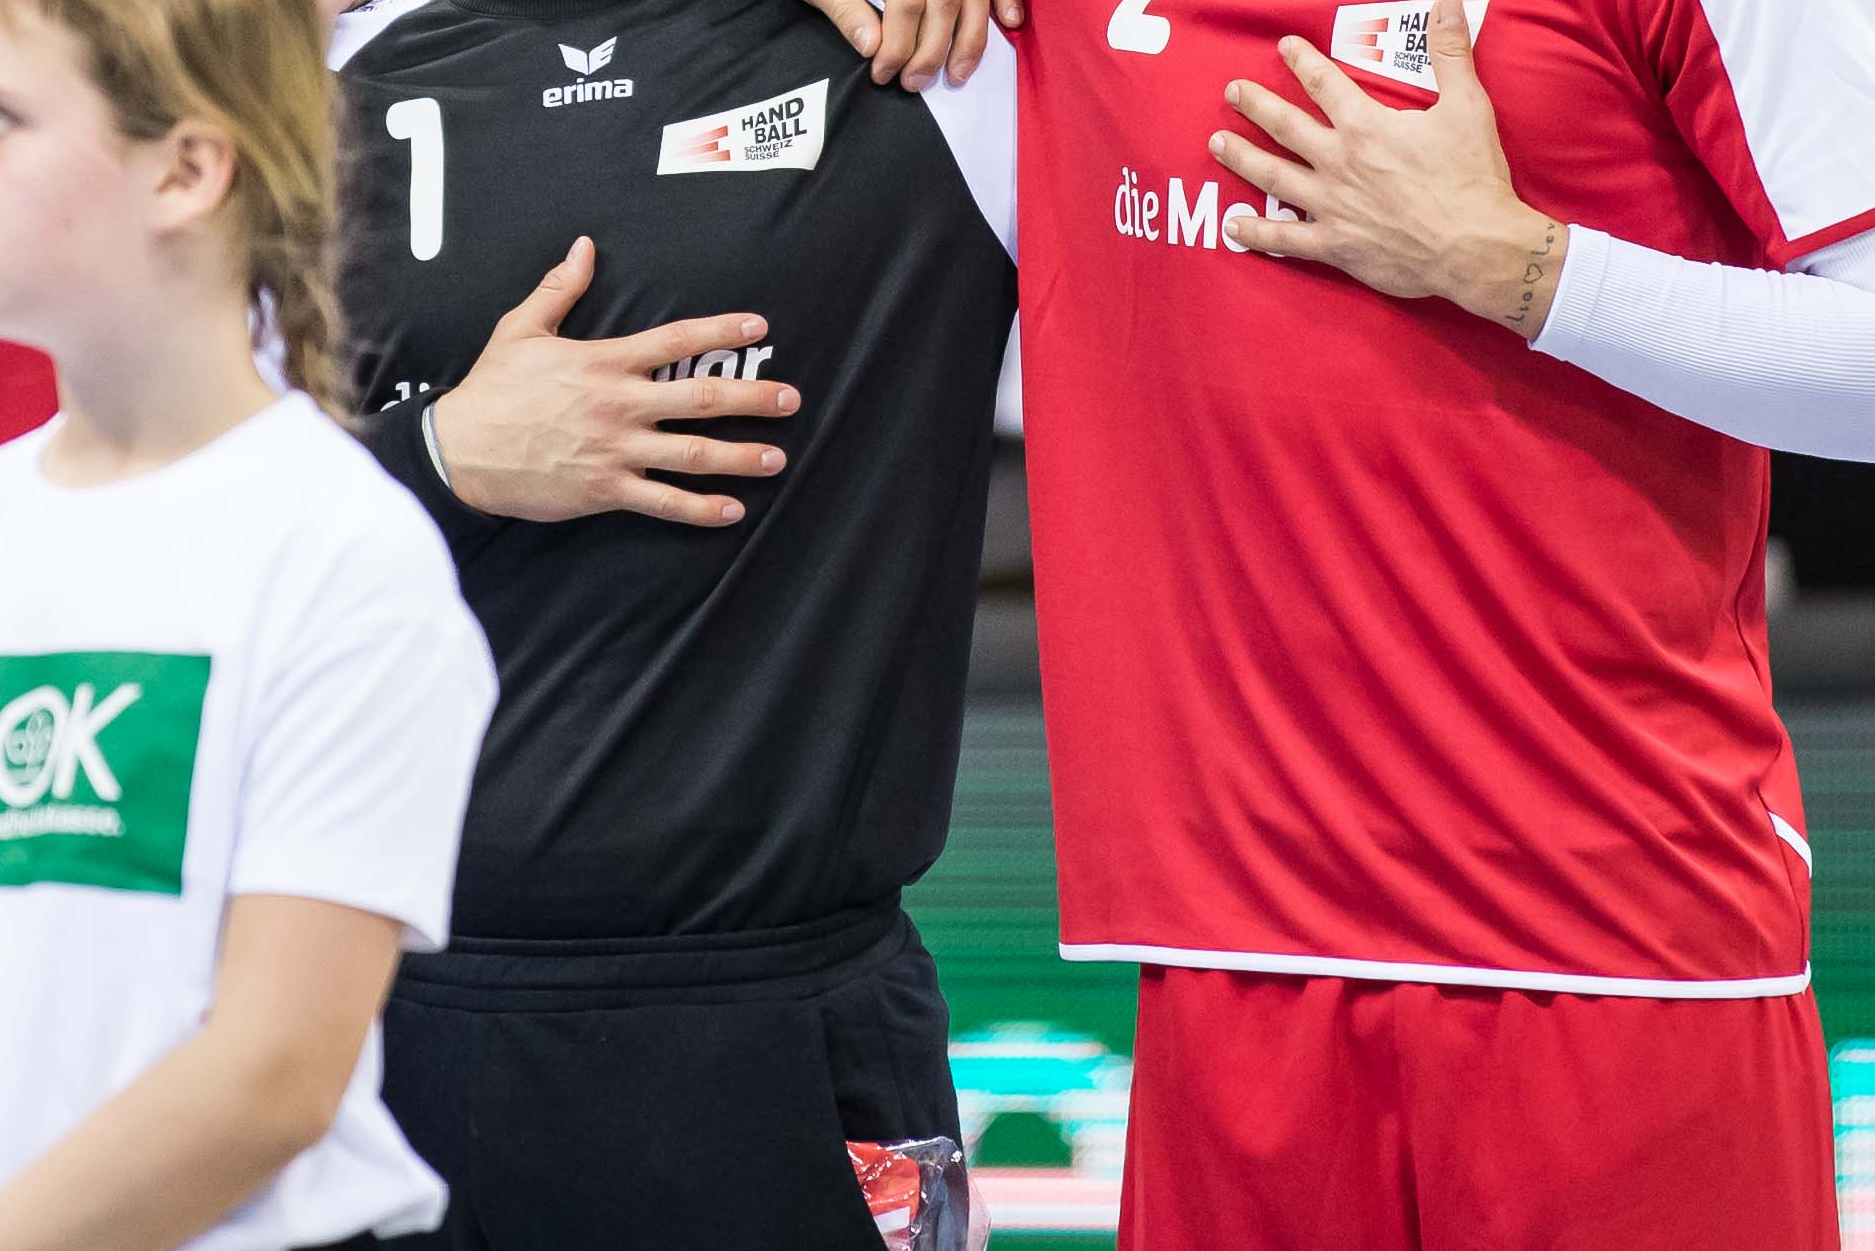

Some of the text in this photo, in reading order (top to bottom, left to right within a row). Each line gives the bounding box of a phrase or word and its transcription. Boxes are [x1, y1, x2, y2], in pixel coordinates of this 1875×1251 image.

[1398, 12, 1430, 32] HA
[1405, 33, 1428, 53] BA
[1393, 59, 1423, 73] SUISSE
[1394, 51, 1432, 66] SCHWEI
[542, 78, 634, 108] erima
[741, 97, 805, 131] HAND
[754, 118, 808, 144] BALL
[744, 139, 794, 153] SCHWEIZ
[744, 150, 781, 161] SUISSE
[385, 97, 444, 261] 1
[1114, 166, 1160, 241] die
